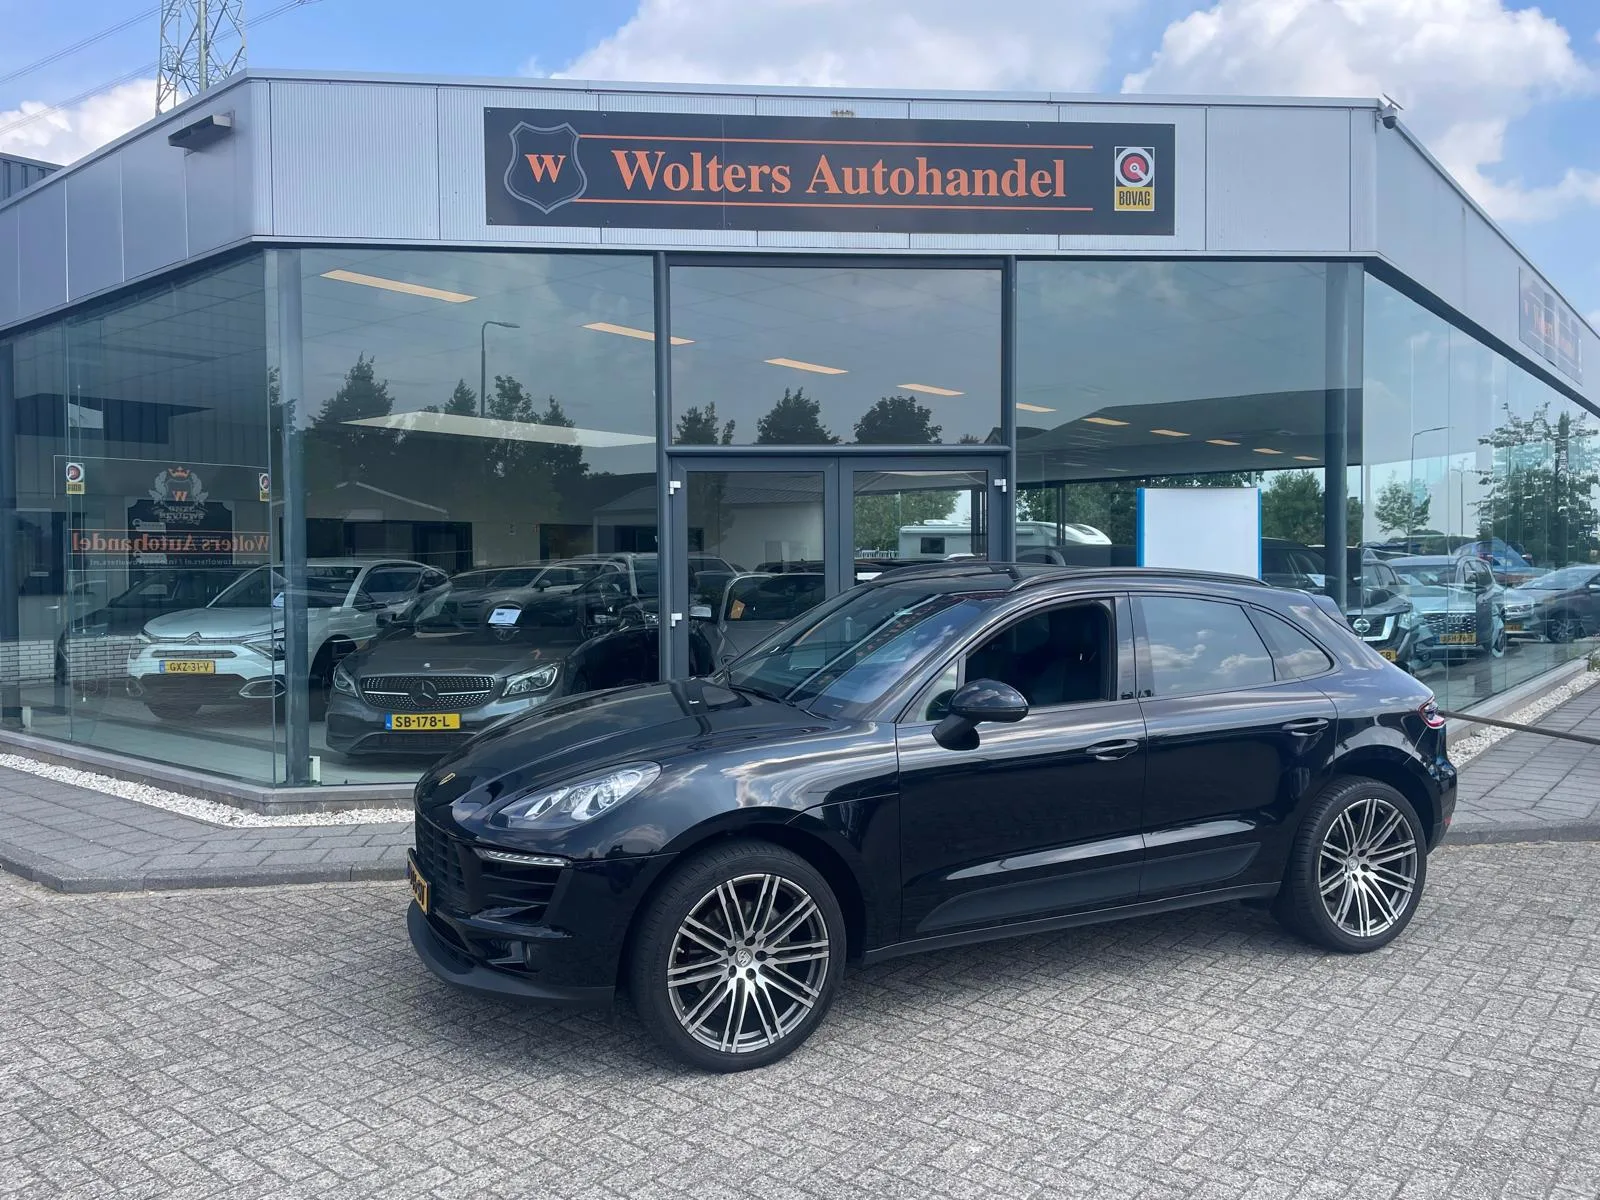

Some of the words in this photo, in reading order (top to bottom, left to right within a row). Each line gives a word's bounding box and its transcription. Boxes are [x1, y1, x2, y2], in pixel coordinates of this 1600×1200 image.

[525, 154, 566, 184] W
[611, 149, 791, 193] Wolters
[805, 154, 1067, 198] Autohandel
[1118, 187, 1151, 207] BOVAG
[169, 662, 209, 672] GXZ-31-V
[395, 716, 450, 728] SB-178-L
